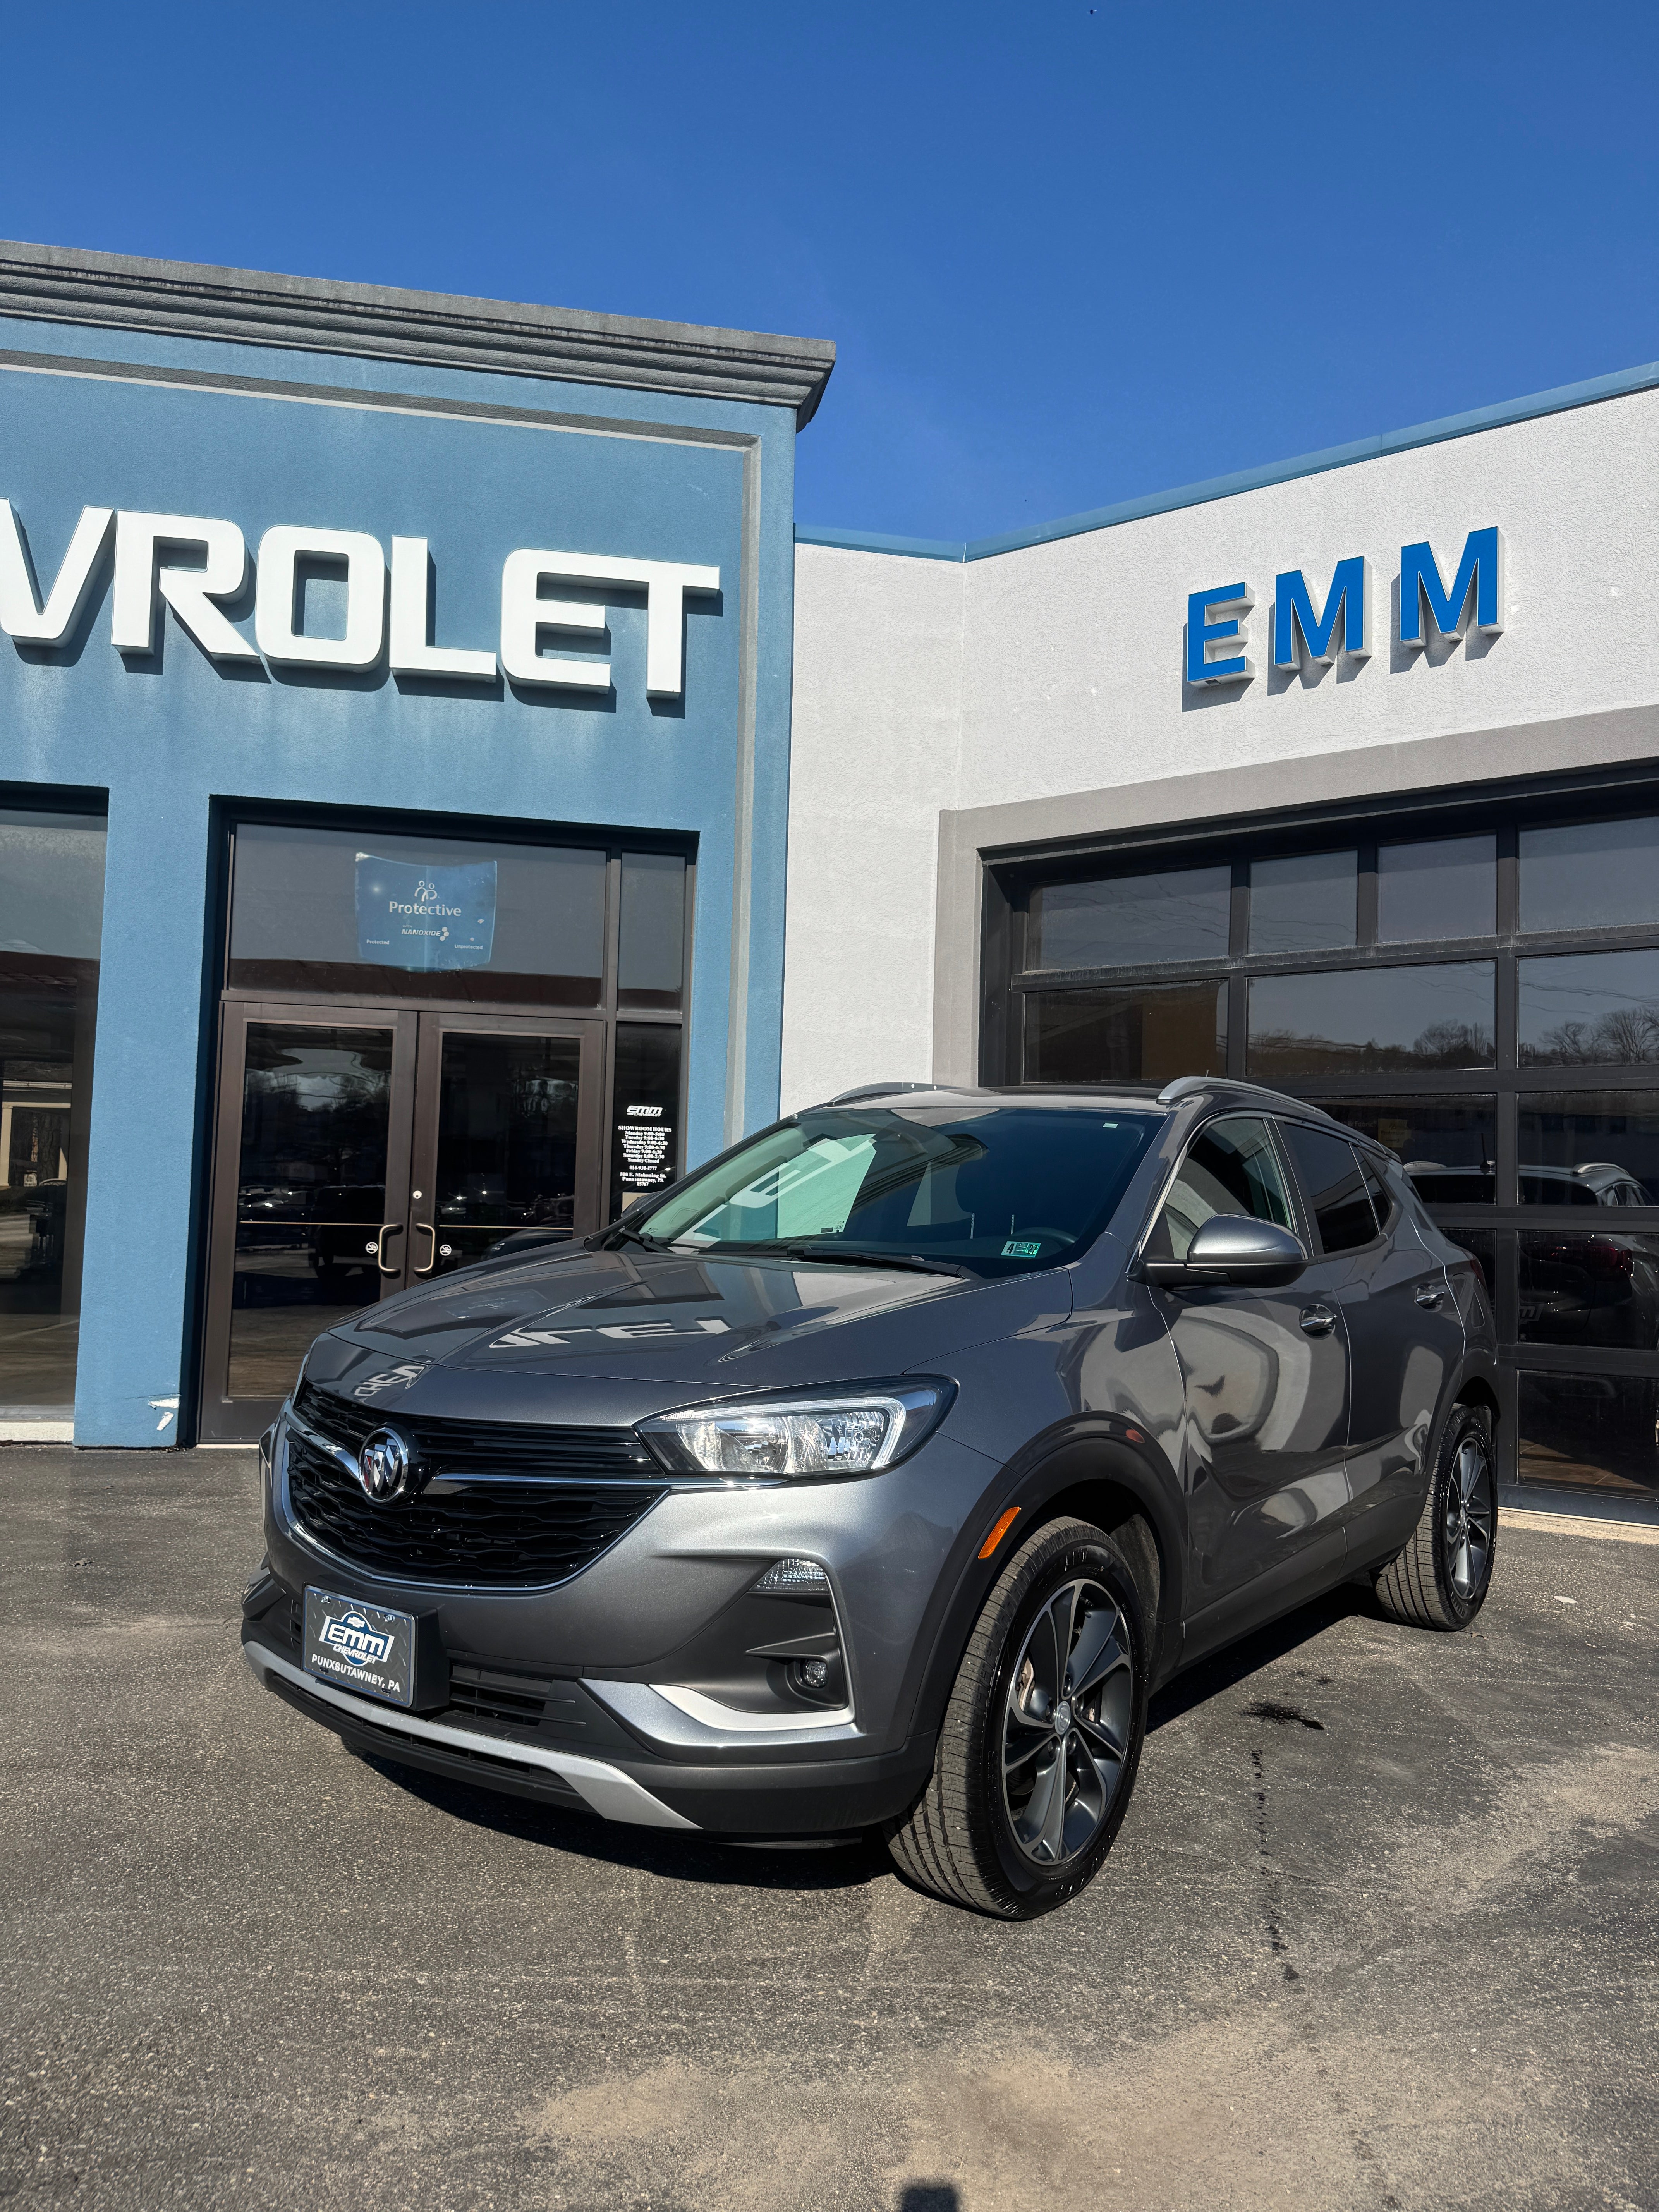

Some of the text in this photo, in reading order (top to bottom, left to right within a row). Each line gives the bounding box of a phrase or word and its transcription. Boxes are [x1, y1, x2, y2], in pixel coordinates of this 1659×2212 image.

[1187, 526, 1504, 688] EMM
[389, 901, 462, 917] Protective
[1007, 1243, 1015, 1254] 4
[333, 1643, 378, 1664] CHEVROLET
[311, 1654, 400, 1693] PUNXSUTAWNEY, PA
